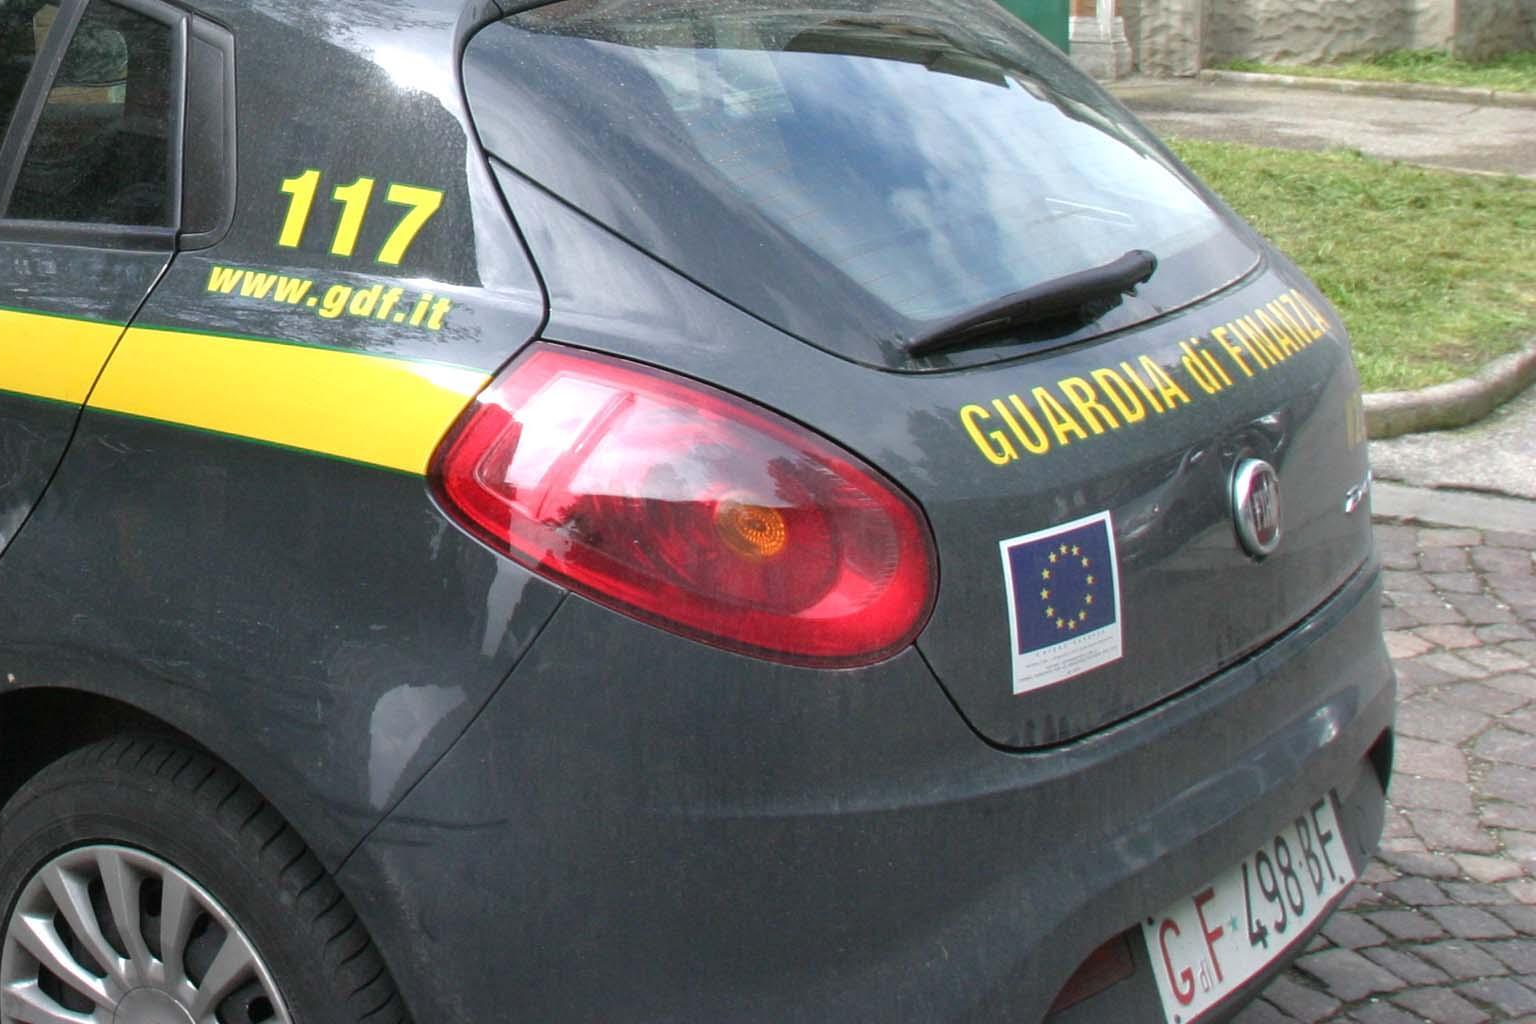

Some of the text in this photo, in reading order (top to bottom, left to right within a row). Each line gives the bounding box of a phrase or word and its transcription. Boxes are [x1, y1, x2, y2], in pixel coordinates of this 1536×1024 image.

[278, 169, 445, 265] 117
[207, 266, 453, 331] www.gdf.it
[960, 289, 1331, 466] GUARDIA di FINANZA
